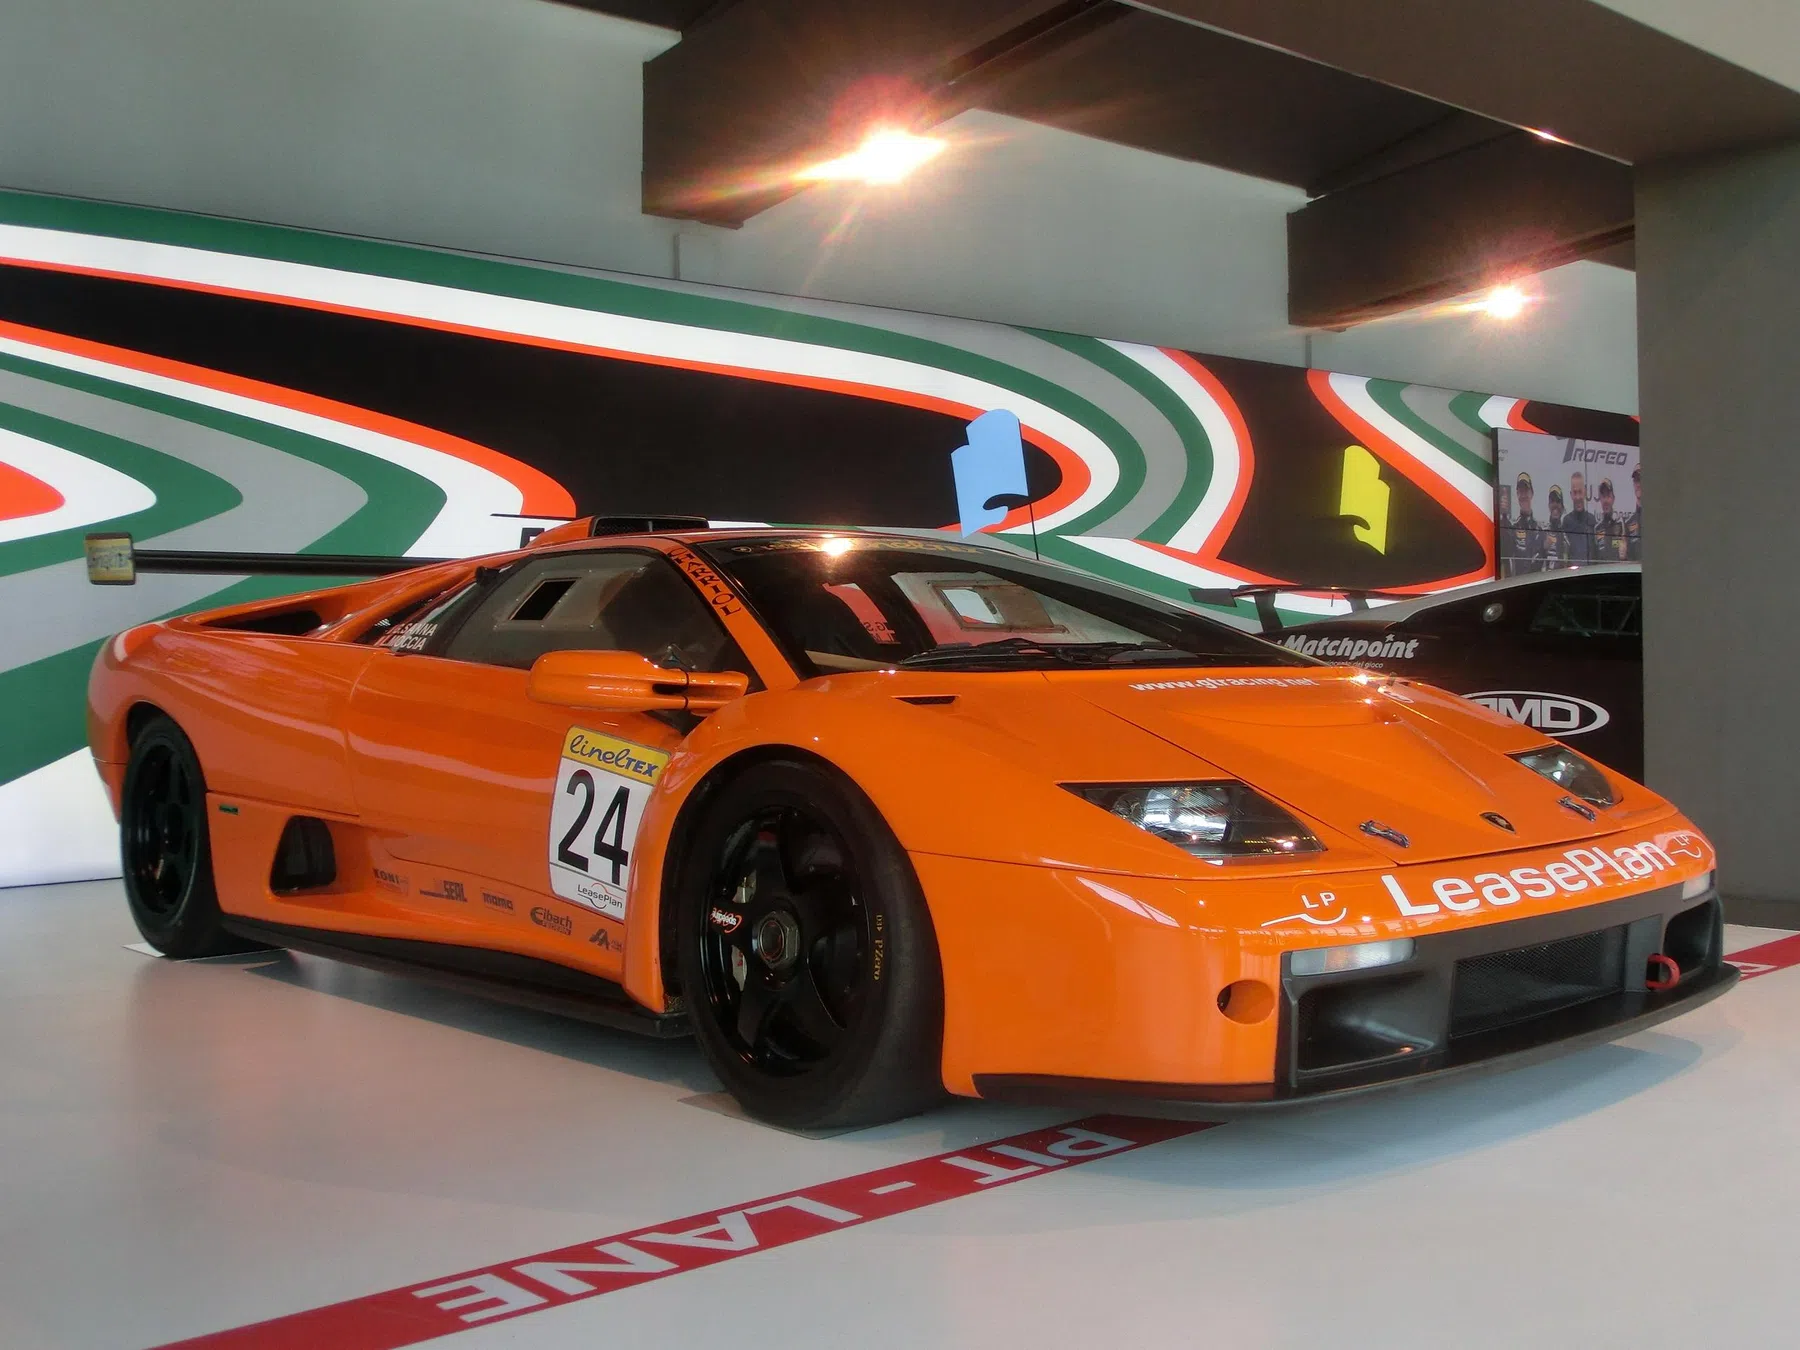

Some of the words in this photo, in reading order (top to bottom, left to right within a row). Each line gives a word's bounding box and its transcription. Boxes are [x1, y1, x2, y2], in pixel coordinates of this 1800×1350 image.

[1284, 634, 1419, 660] Matchpoint
[558, 769, 629, 886] 24
[577, 884, 622, 909] LeasePlan
[1301, 892, 1336, 908] LP
[1381, 840, 1675, 916] LeasePlan
[940, 1126, 1138, 1188] PIT
[411, 1195, 865, 1324] LANE
